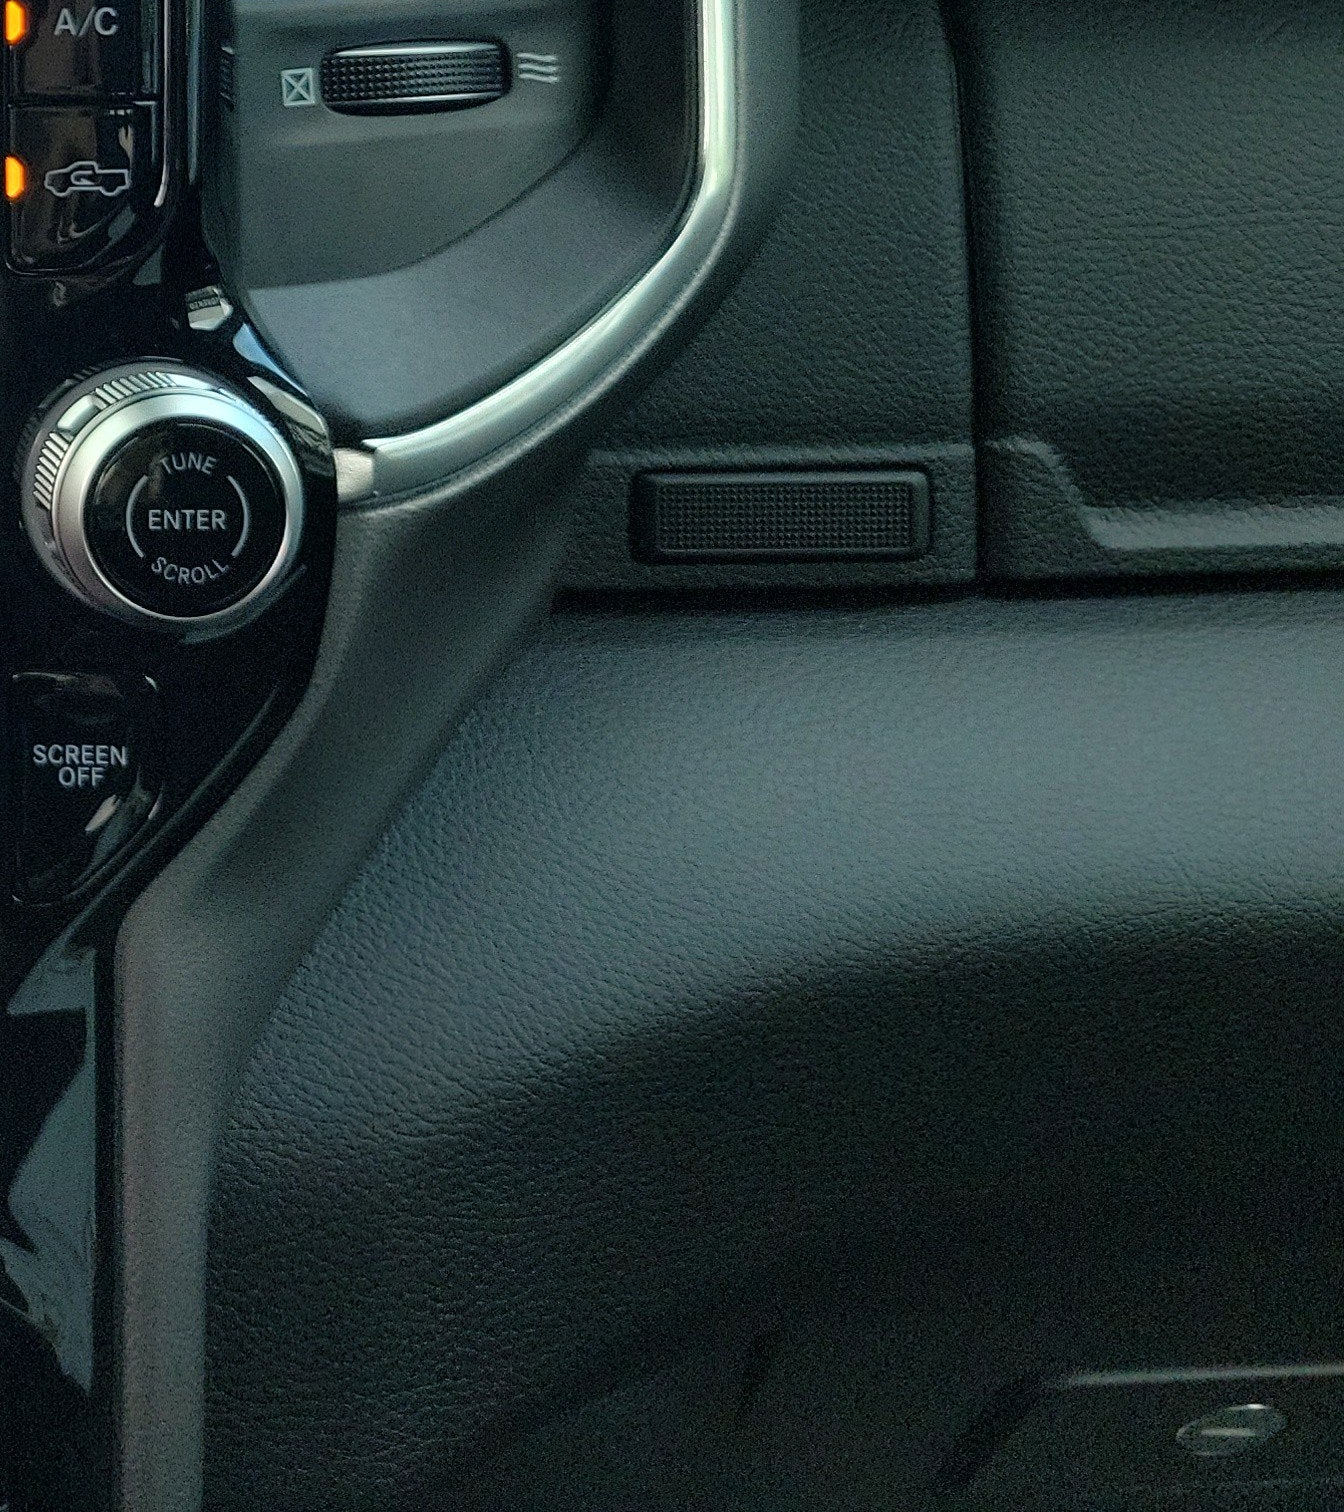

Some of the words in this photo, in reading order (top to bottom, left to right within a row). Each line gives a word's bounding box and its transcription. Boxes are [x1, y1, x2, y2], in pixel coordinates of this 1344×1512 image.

[54, 7, 118, 36] A/C
[160, 452, 219, 474] TUNE
[148, 509, 226, 531] ENTER
[151, 556, 231, 585] SCROLL
[33, 744, 127, 767] SCREEN
[58, 767, 105, 787] OFF
